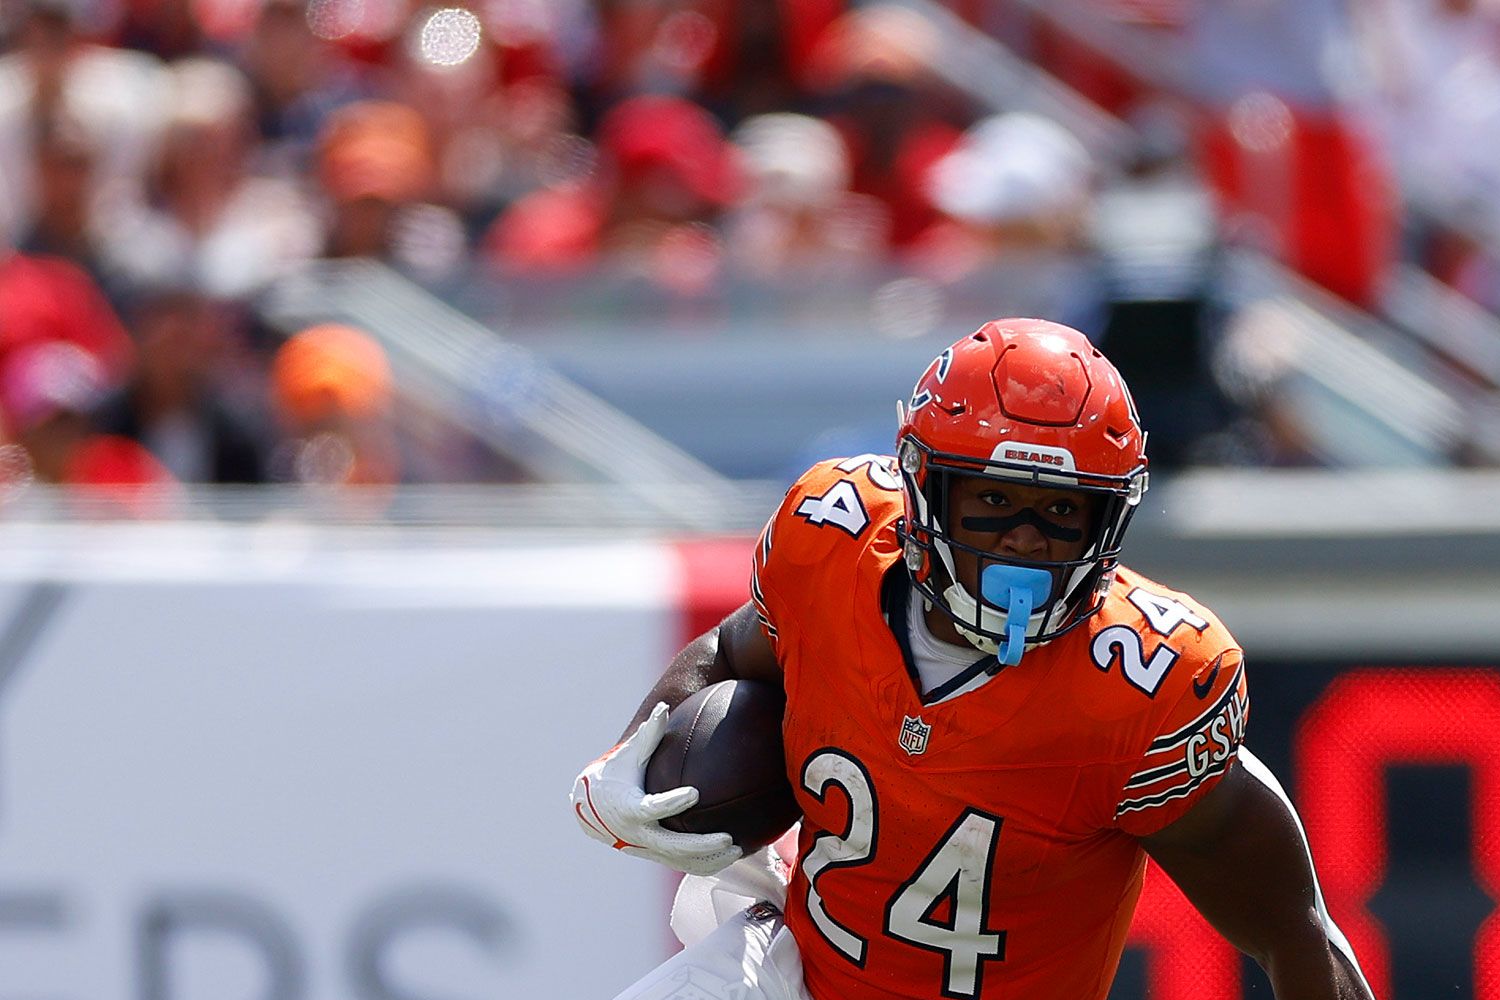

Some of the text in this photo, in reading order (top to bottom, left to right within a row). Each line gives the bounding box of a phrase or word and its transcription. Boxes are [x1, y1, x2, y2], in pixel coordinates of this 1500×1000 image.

[793, 453, 904, 540] 24
[1005, 449, 1064, 466] BEARS
[1089, 586, 1209, 698] 24
[902, 729, 923, 750] NFL
[1186, 690, 1243, 778] GSH
